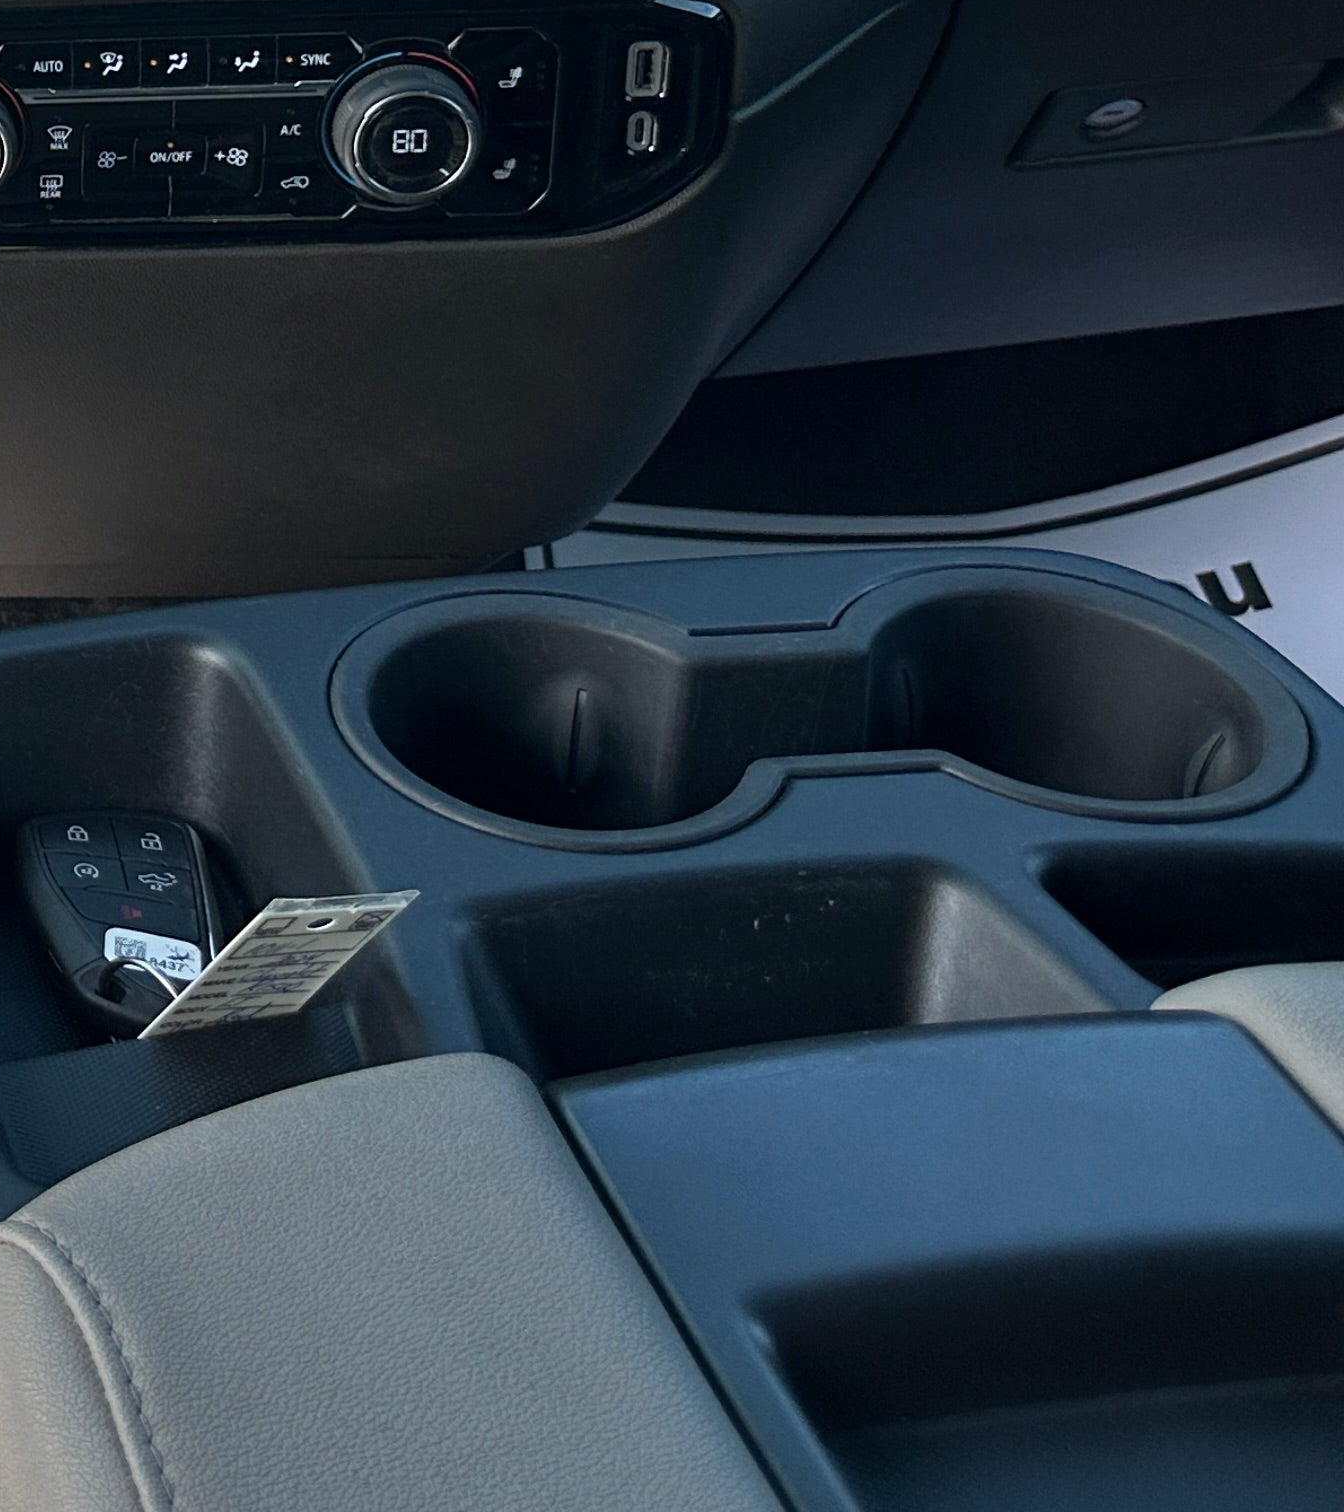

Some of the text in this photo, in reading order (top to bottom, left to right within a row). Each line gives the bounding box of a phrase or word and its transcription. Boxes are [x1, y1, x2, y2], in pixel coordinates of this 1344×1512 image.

[300, 53, 332, 66] SYNC
[32, 60, 64, 73] AUTO
[280, 124, 302, 137] A/C
[50, 141, 69, 150] MAX
[391, 129, 428, 154] 80
[149, 150, 193, 164] ON/OFF
[40, 190, 62, 199] REAR
